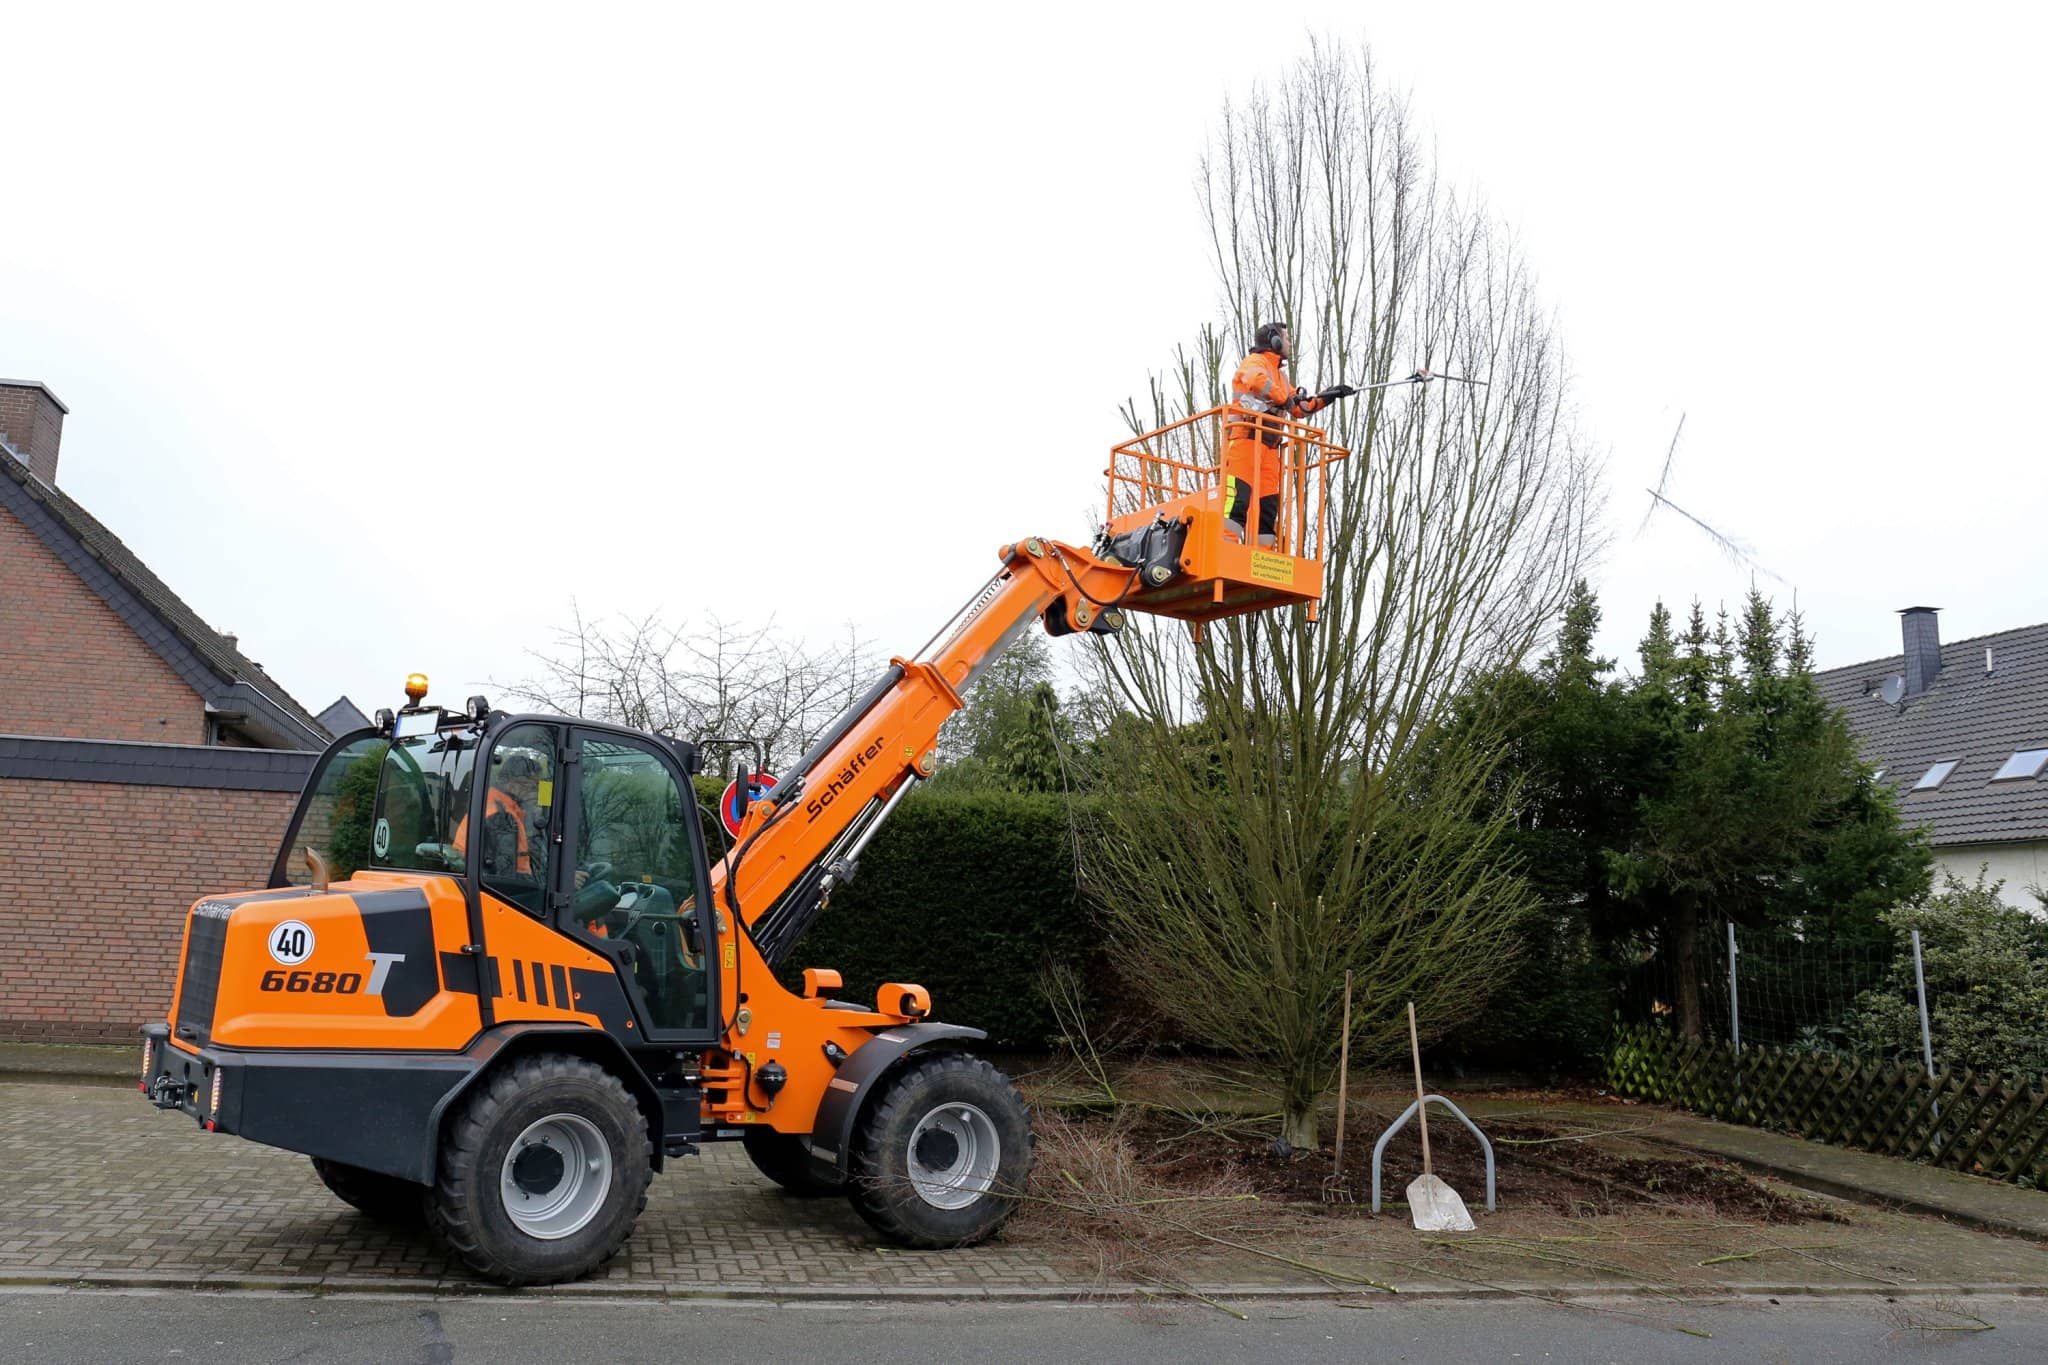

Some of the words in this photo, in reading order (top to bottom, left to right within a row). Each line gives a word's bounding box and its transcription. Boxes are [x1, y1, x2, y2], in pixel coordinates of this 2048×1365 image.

[806, 737, 884, 824] Schäffer
[376, 825, 387, 849] 40
[277, 928, 305, 958] 40
